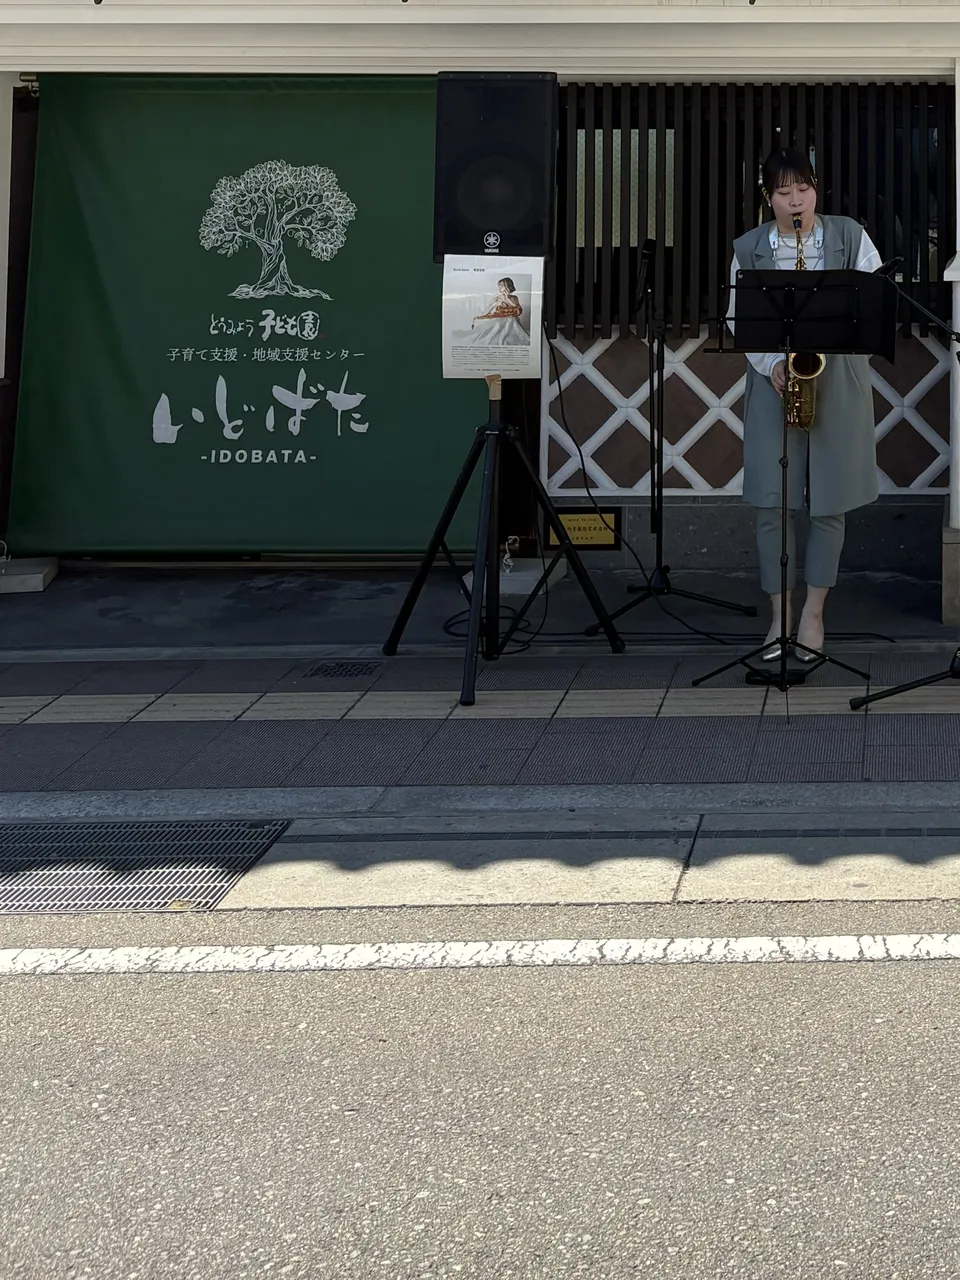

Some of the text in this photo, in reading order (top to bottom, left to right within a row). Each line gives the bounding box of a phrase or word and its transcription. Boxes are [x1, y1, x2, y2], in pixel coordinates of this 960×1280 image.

[166, 347, 365, 362] 子育て支援・地域支援センター
[152, 367, 370, 444] いどばた
